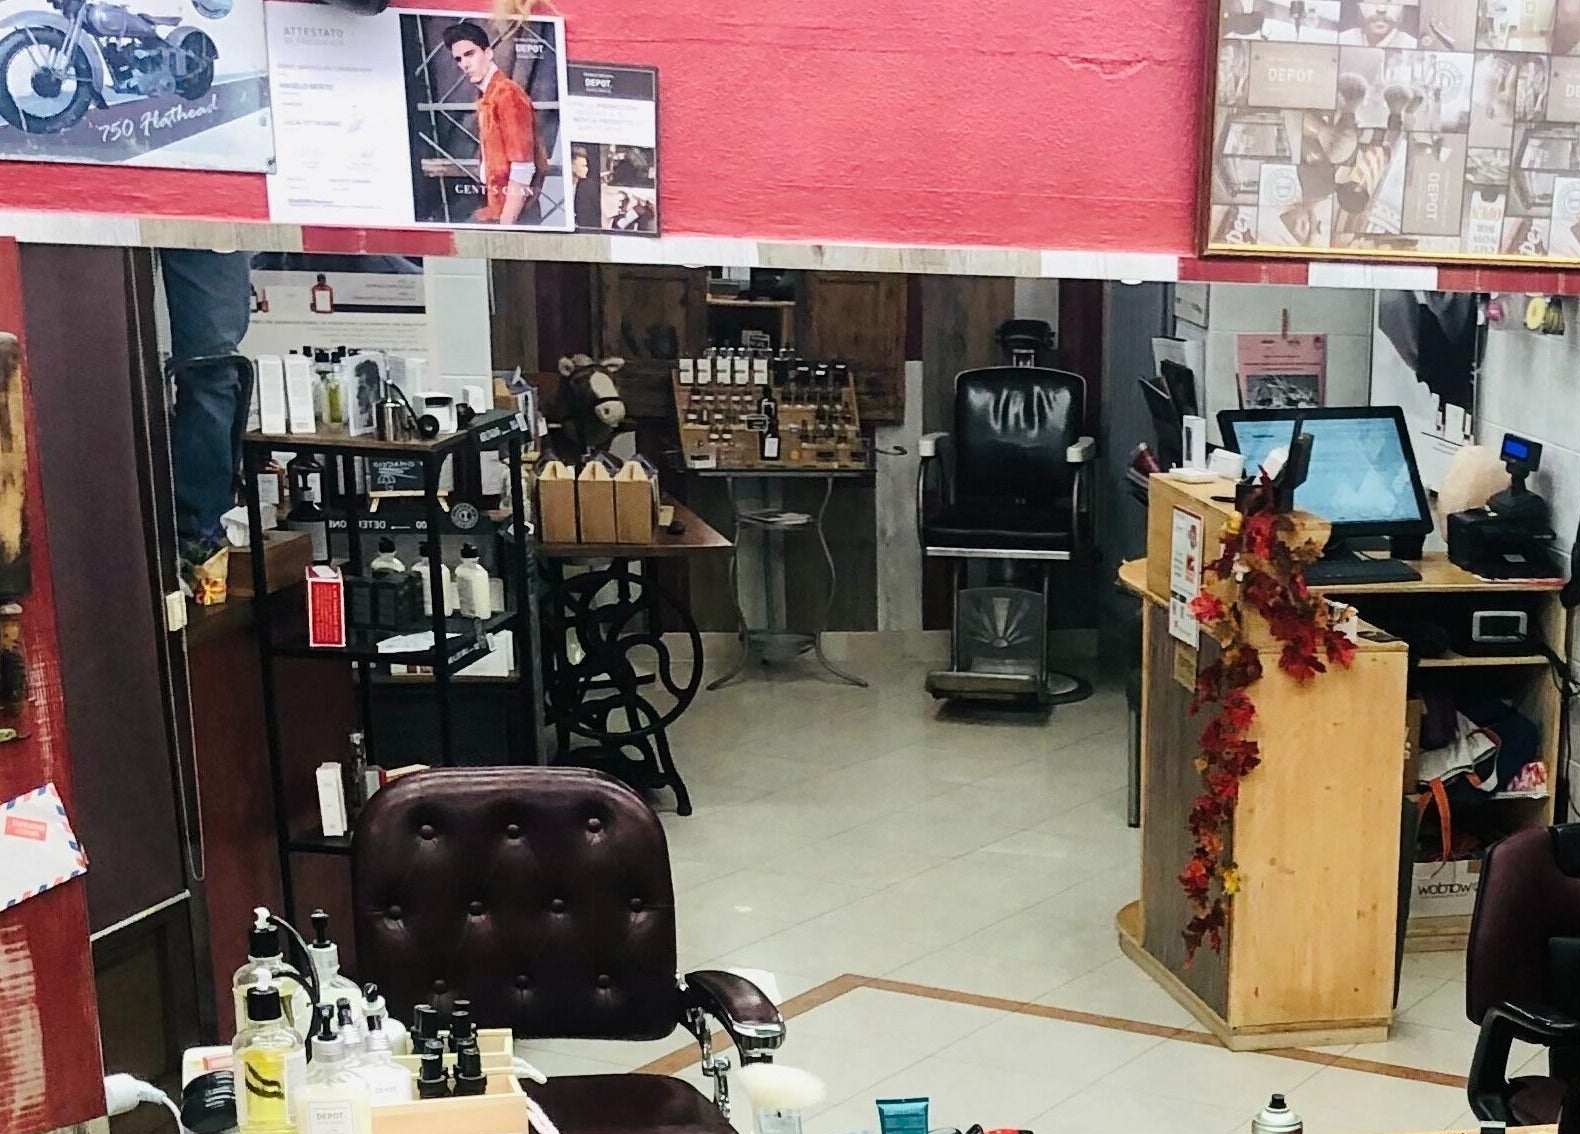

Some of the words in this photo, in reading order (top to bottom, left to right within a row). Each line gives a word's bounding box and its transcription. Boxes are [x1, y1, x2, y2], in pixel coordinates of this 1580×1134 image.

[284, 27, 344, 38] ATTESTATO
[515, 43, 544, 53] DEPOT
[1268, 67, 1315, 82] DEPOT
[584, 78, 611, 88] DEPOT
[98, 119, 134, 142] 750
[140, 93, 219, 136] Flathead
[1425, 172, 1440, 221] DEPOT
[316, 1112, 344, 1121] DEPOT
